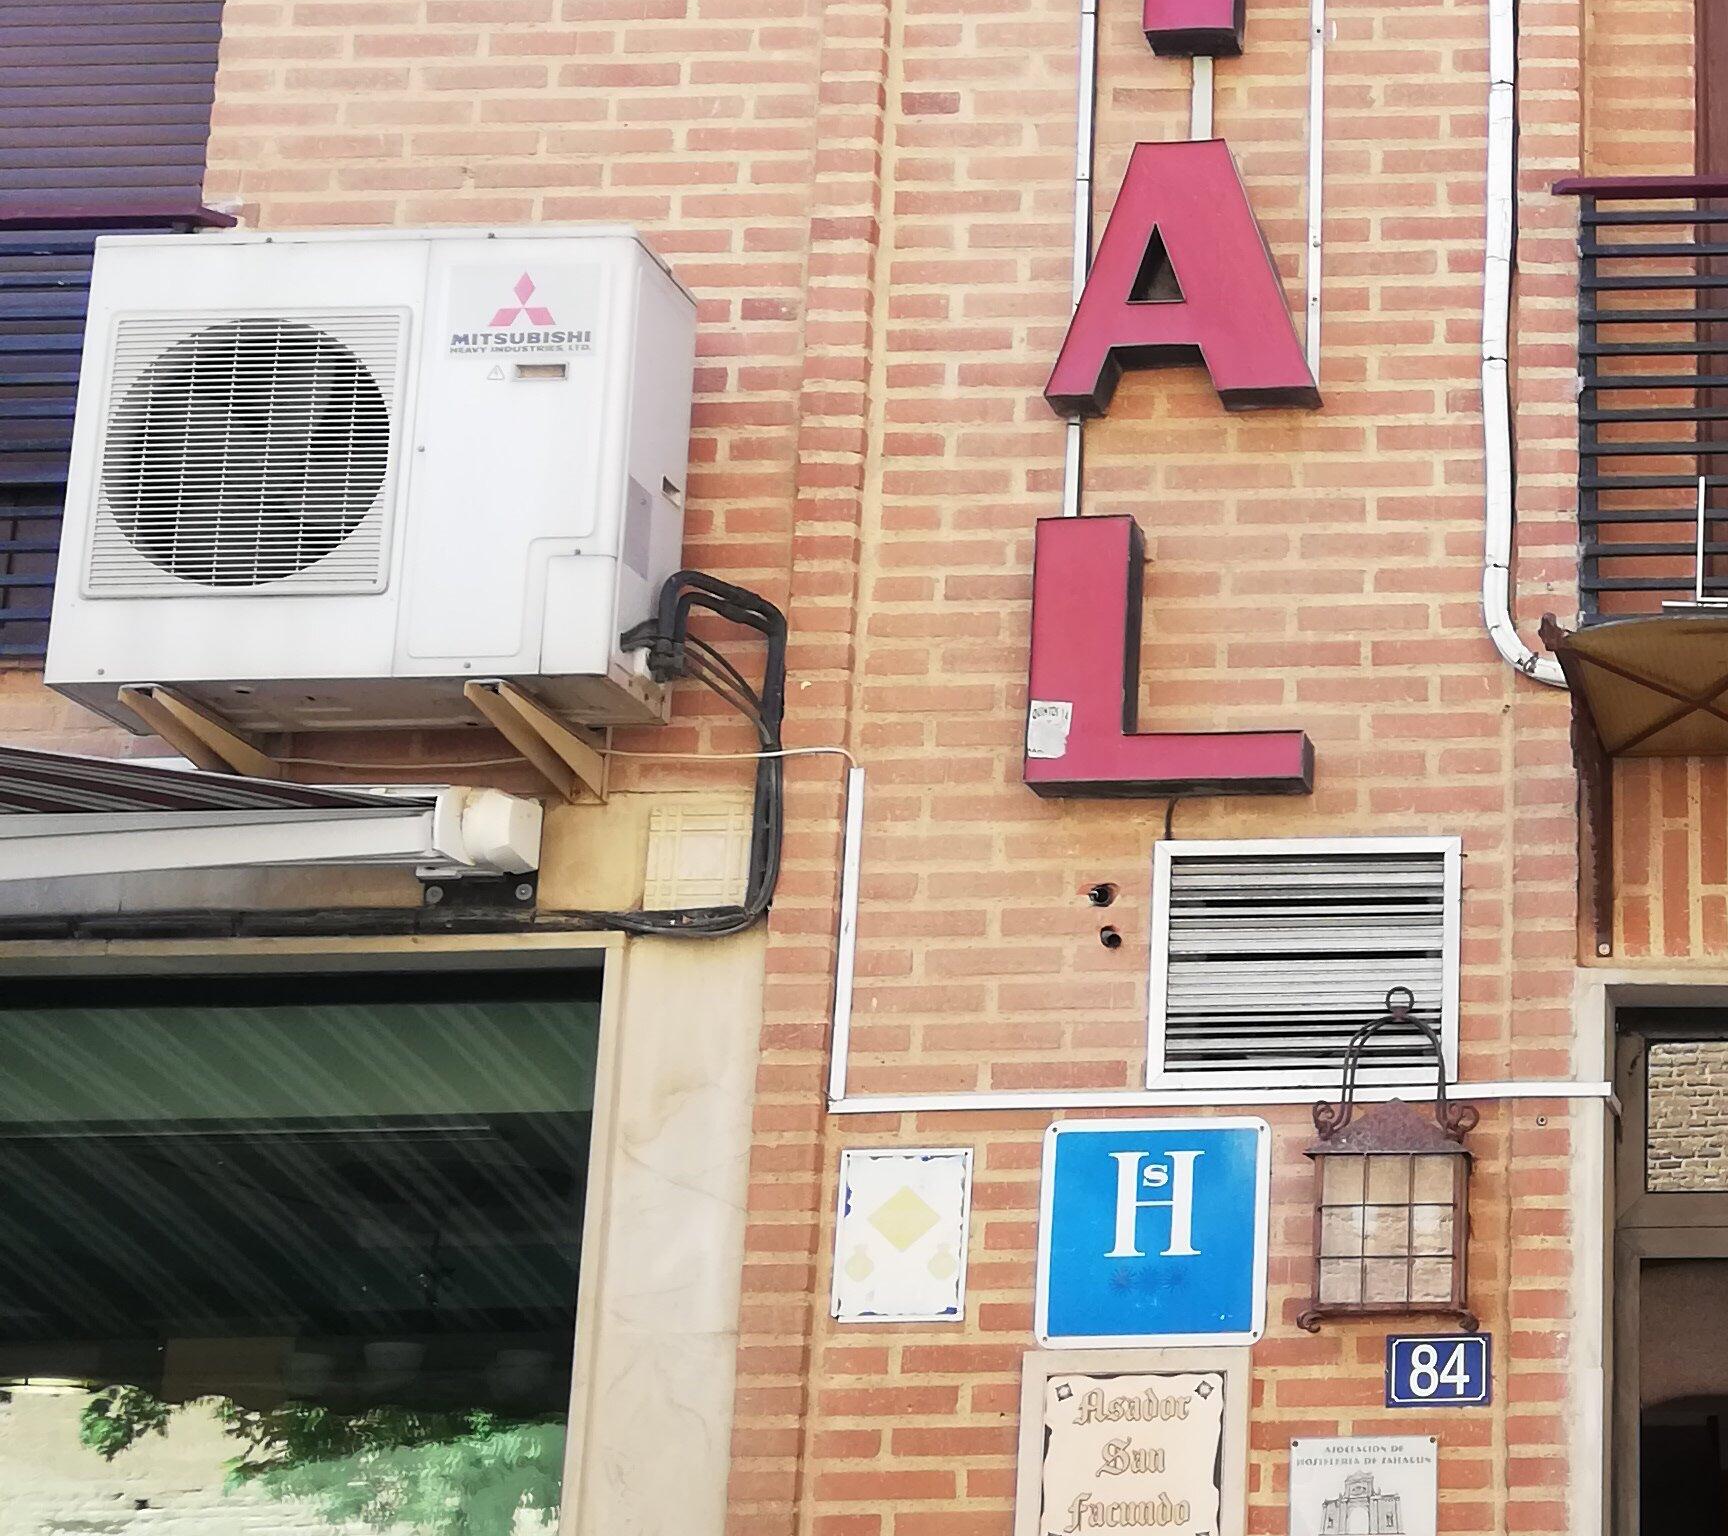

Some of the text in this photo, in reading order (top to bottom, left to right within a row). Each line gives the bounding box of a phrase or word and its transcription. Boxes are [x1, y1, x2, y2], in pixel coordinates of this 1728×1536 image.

[450, 331, 592, 346] MITSUBISHI
[449, 346, 486, 354] HEAVY
[1408, 1345, 1471, 1398] 84
[1072, 1387, 1192, 1426] Asador
[1391, 1444, 1405, 1453] DE
[1096, 1436, 1166, 1477] San
[1364, 1457, 1377, 1465] DE
